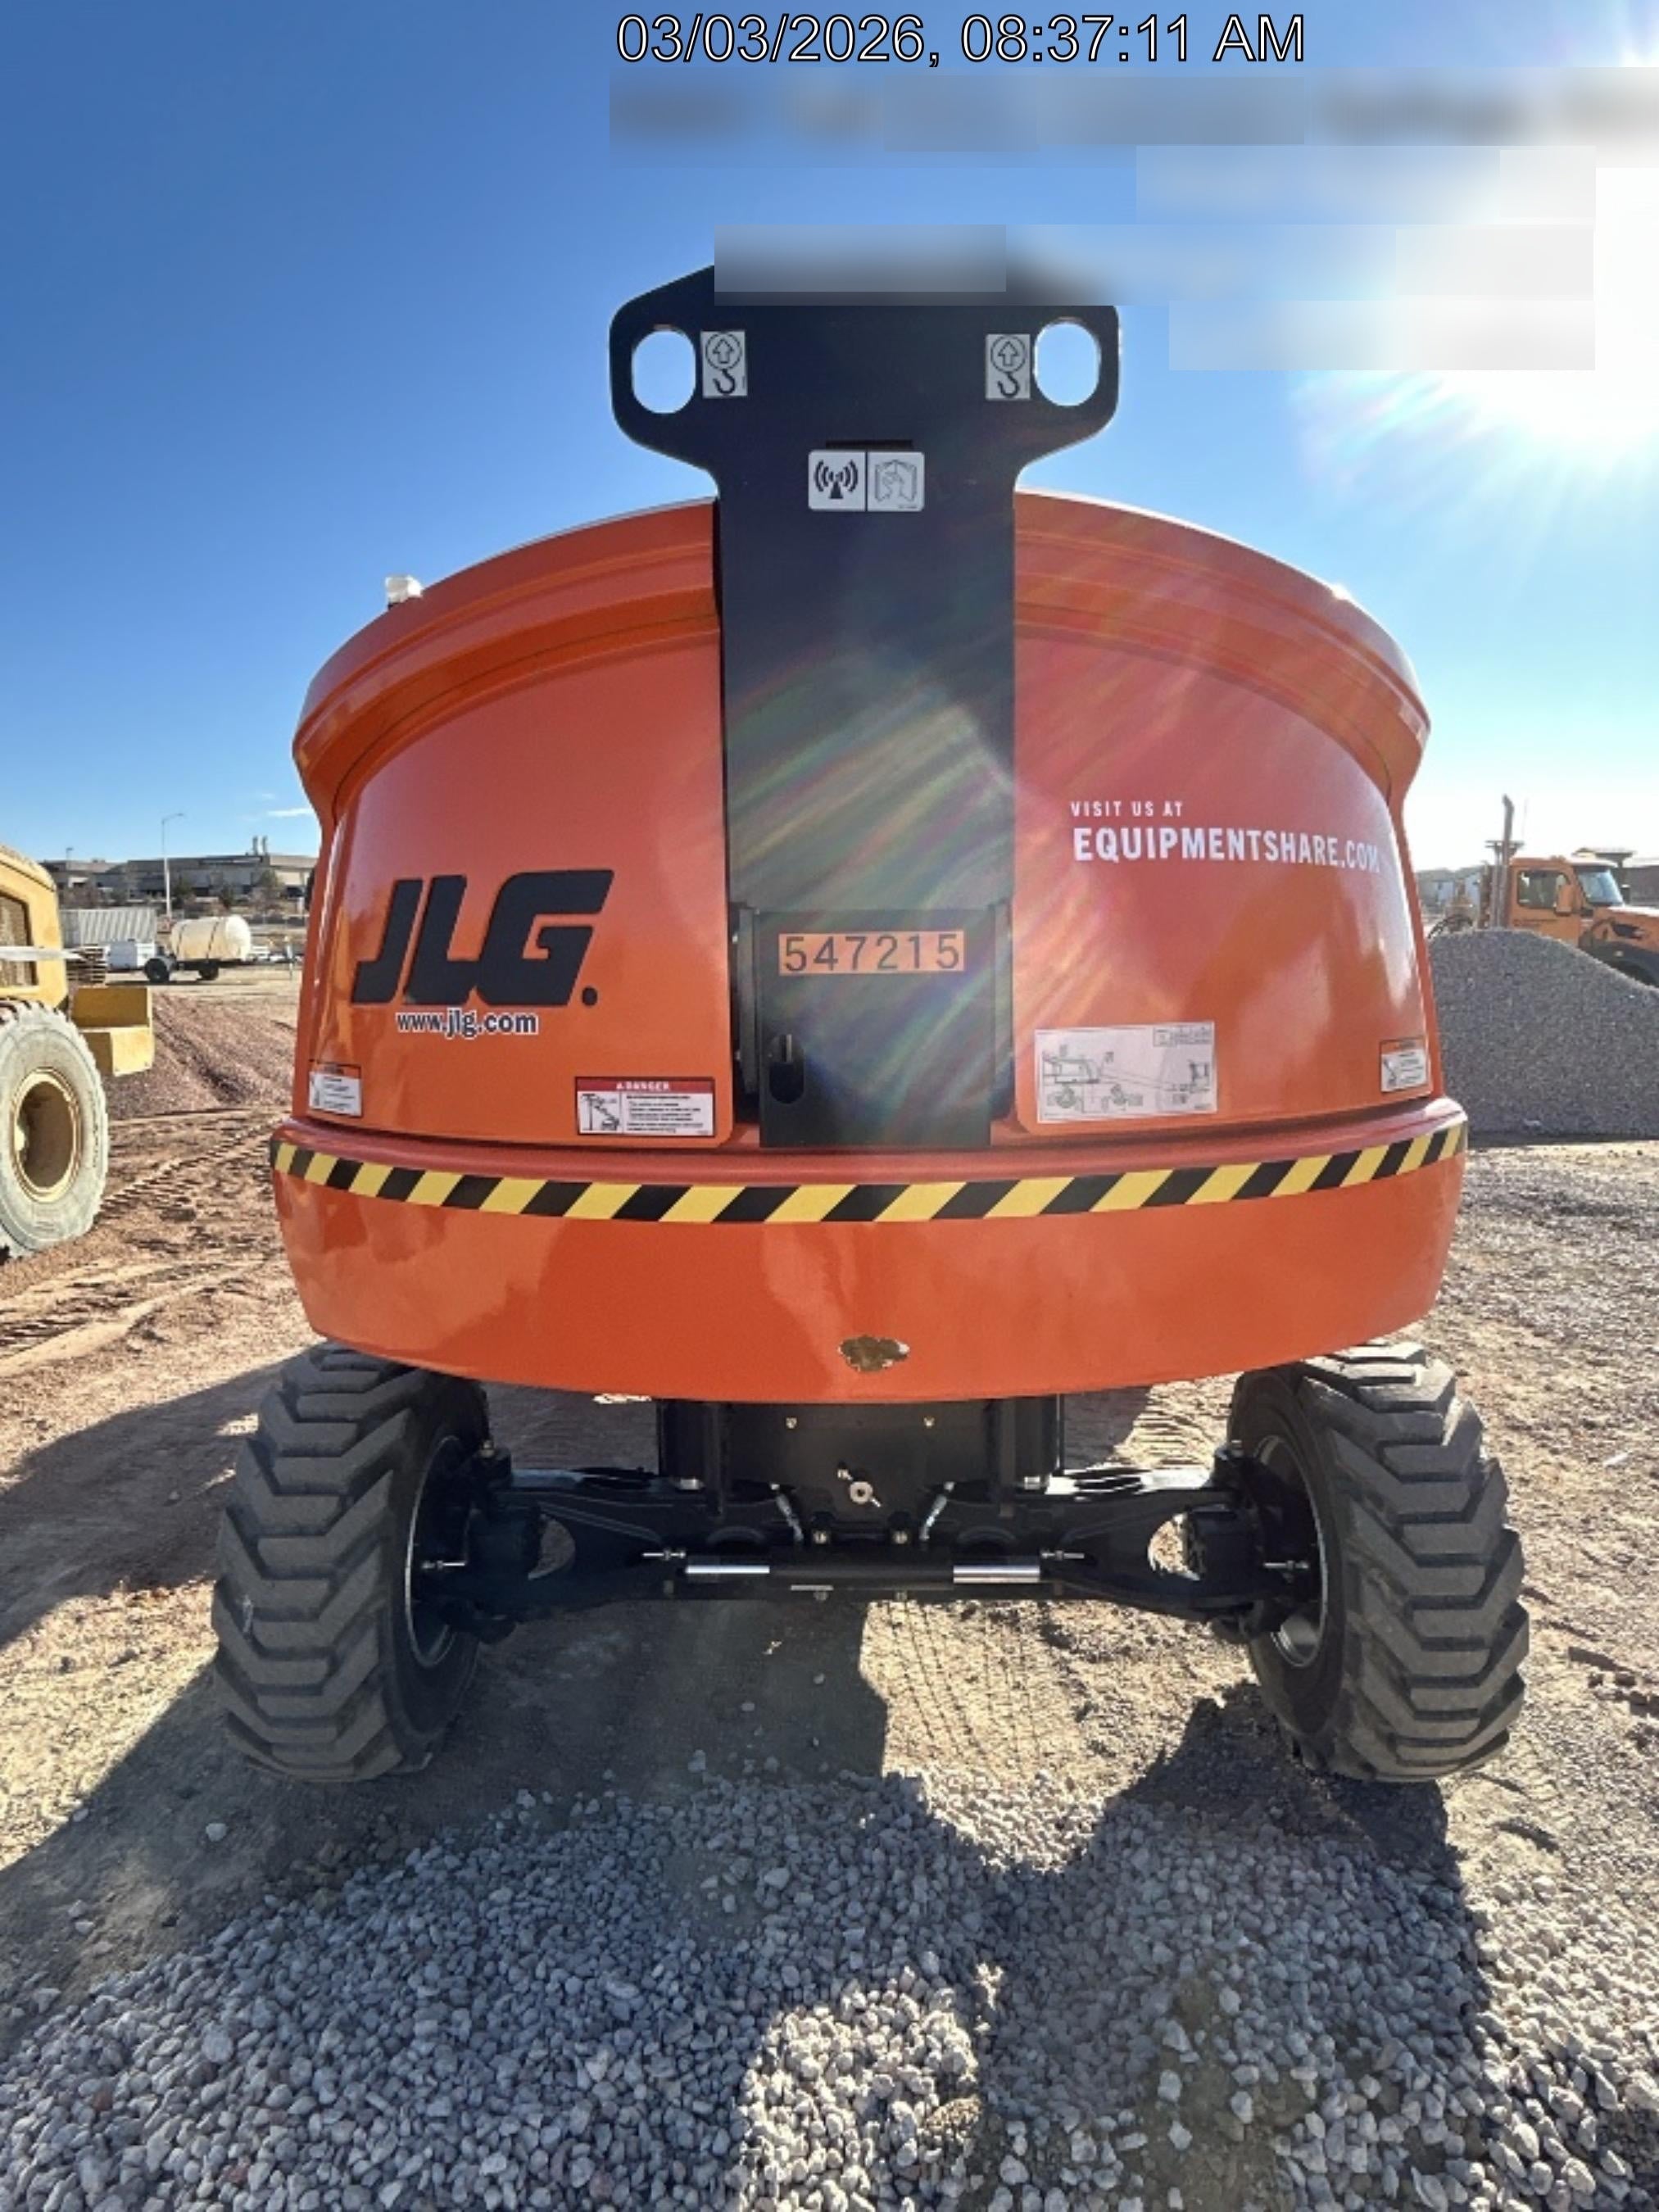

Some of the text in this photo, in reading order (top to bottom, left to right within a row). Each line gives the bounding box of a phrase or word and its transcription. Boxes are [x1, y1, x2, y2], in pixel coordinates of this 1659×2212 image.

[1071, 800, 1184, 817] VISIT US AT
[1073, 827, 1380, 873] EQUIPMENTSHARE.COM
[783, 933, 960, 972] 547215
[396, 1008, 538, 1040] www.jlg.com
